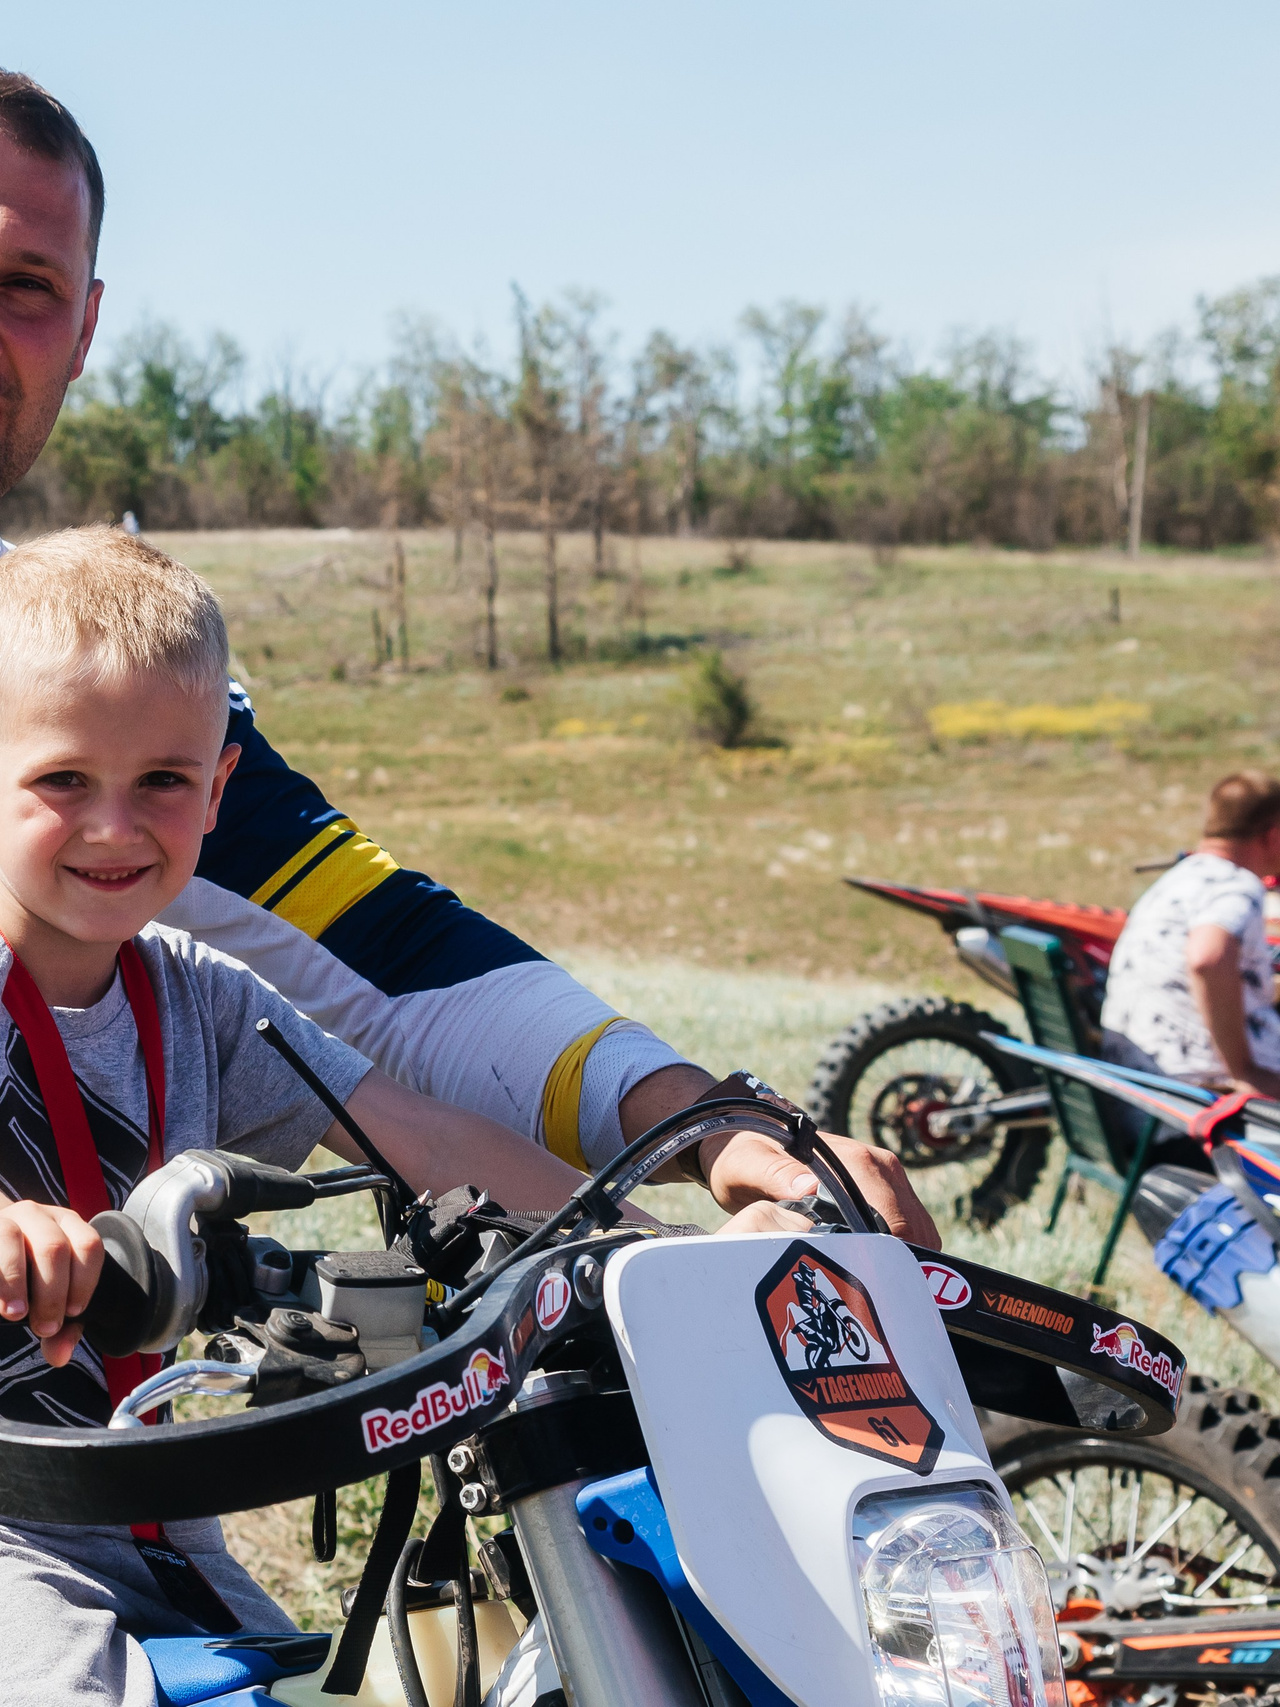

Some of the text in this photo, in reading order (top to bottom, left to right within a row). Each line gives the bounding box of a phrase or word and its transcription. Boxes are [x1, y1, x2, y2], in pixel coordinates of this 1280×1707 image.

[997, 1293, 1075, 1335] TAGENDURO
[816, 1372, 907, 1405] TAGENDURO
[867, 1415, 910, 1448] 61
